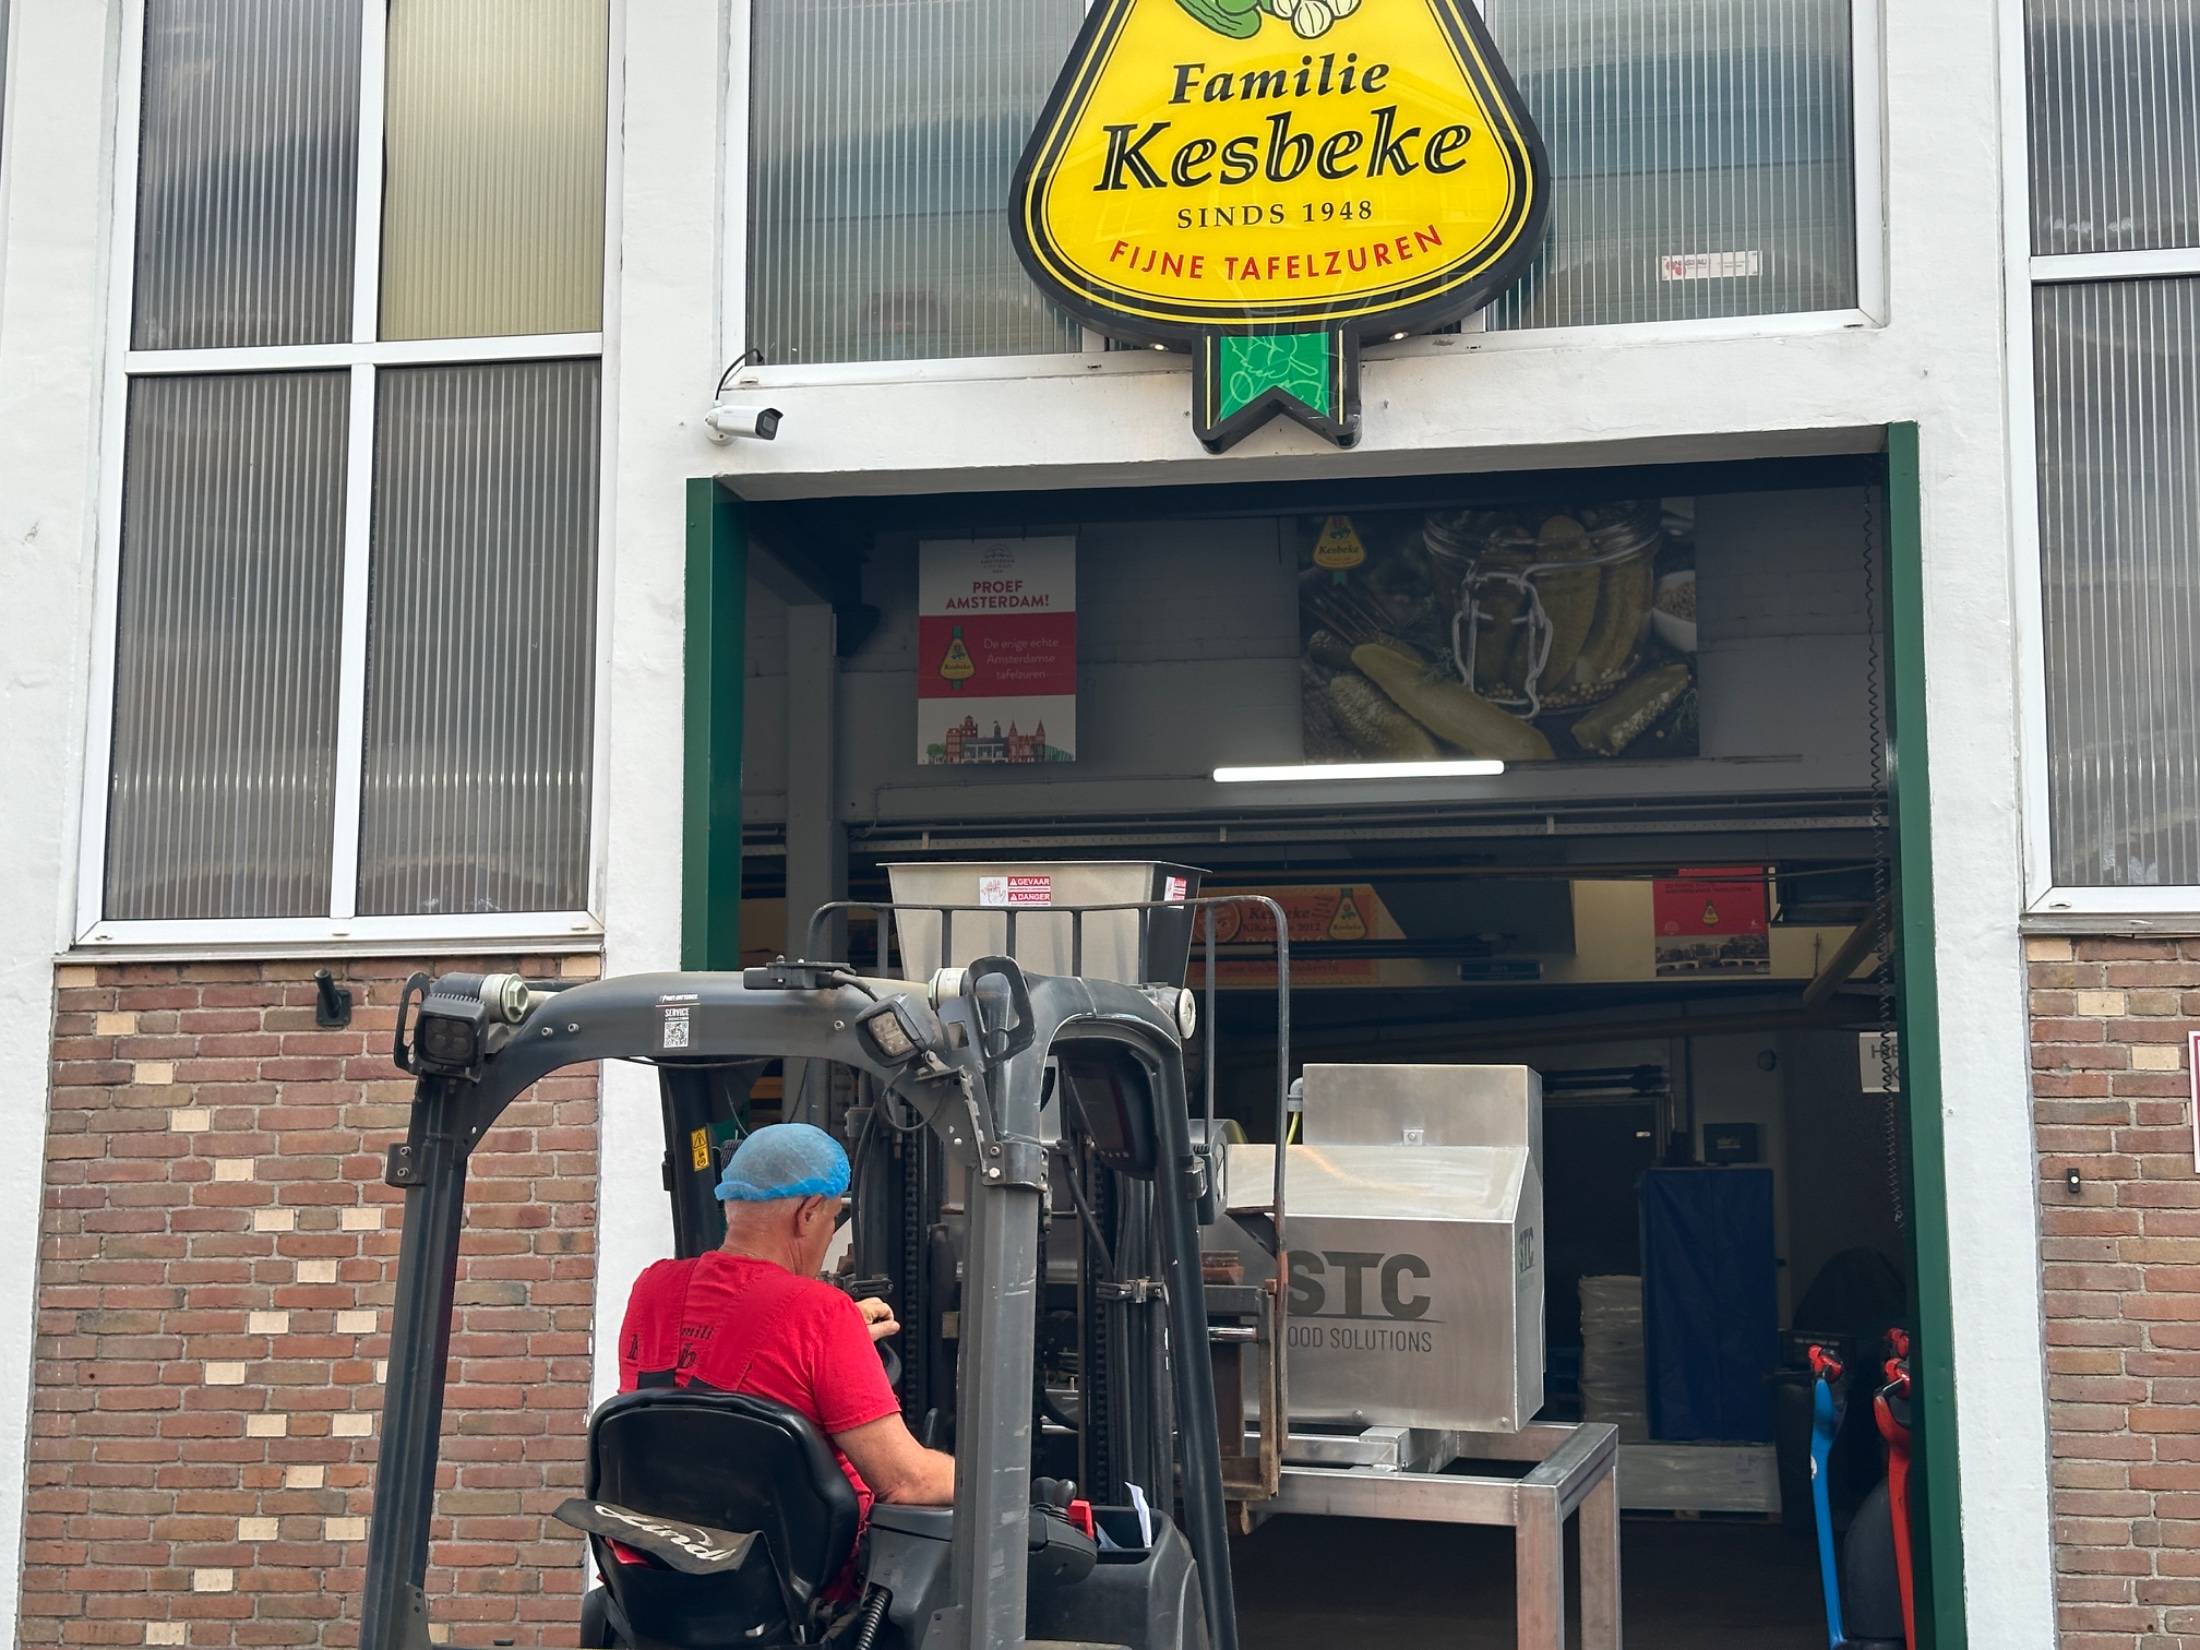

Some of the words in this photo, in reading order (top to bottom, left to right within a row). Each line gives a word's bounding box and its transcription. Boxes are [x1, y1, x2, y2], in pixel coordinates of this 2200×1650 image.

[1168, 52, 1390, 104] Familie
[1093, 105, 1472, 192] Kesbeke
[1177, 202, 1286, 229] SINDS
[1302, 200, 1374, 222] 1948
[1109, 239, 1205, 279] FIJNE
[1225, 224, 1444, 281] TAFELZUREN
[972, 580, 1023, 593] PROEF
[945, 594, 1049, 609] AMSTERDAM!
[983, 639, 998, 649] De
[1001, 638, 1028, 652] enige
[1030, 637, 1059, 647] echte
[986, 653, 1055, 664] Amsterdamse
[996, 668, 1046, 680] tafelzuren
[1017, 877, 1050, 885] GEVAAR
[664, 1007, 690, 1017] SERVICE
[1286, 1250, 1431, 1320] STC
[1287, 1327, 1324, 1349] OOD
[1330, 1327, 1433, 1353] SOLUTIONS
